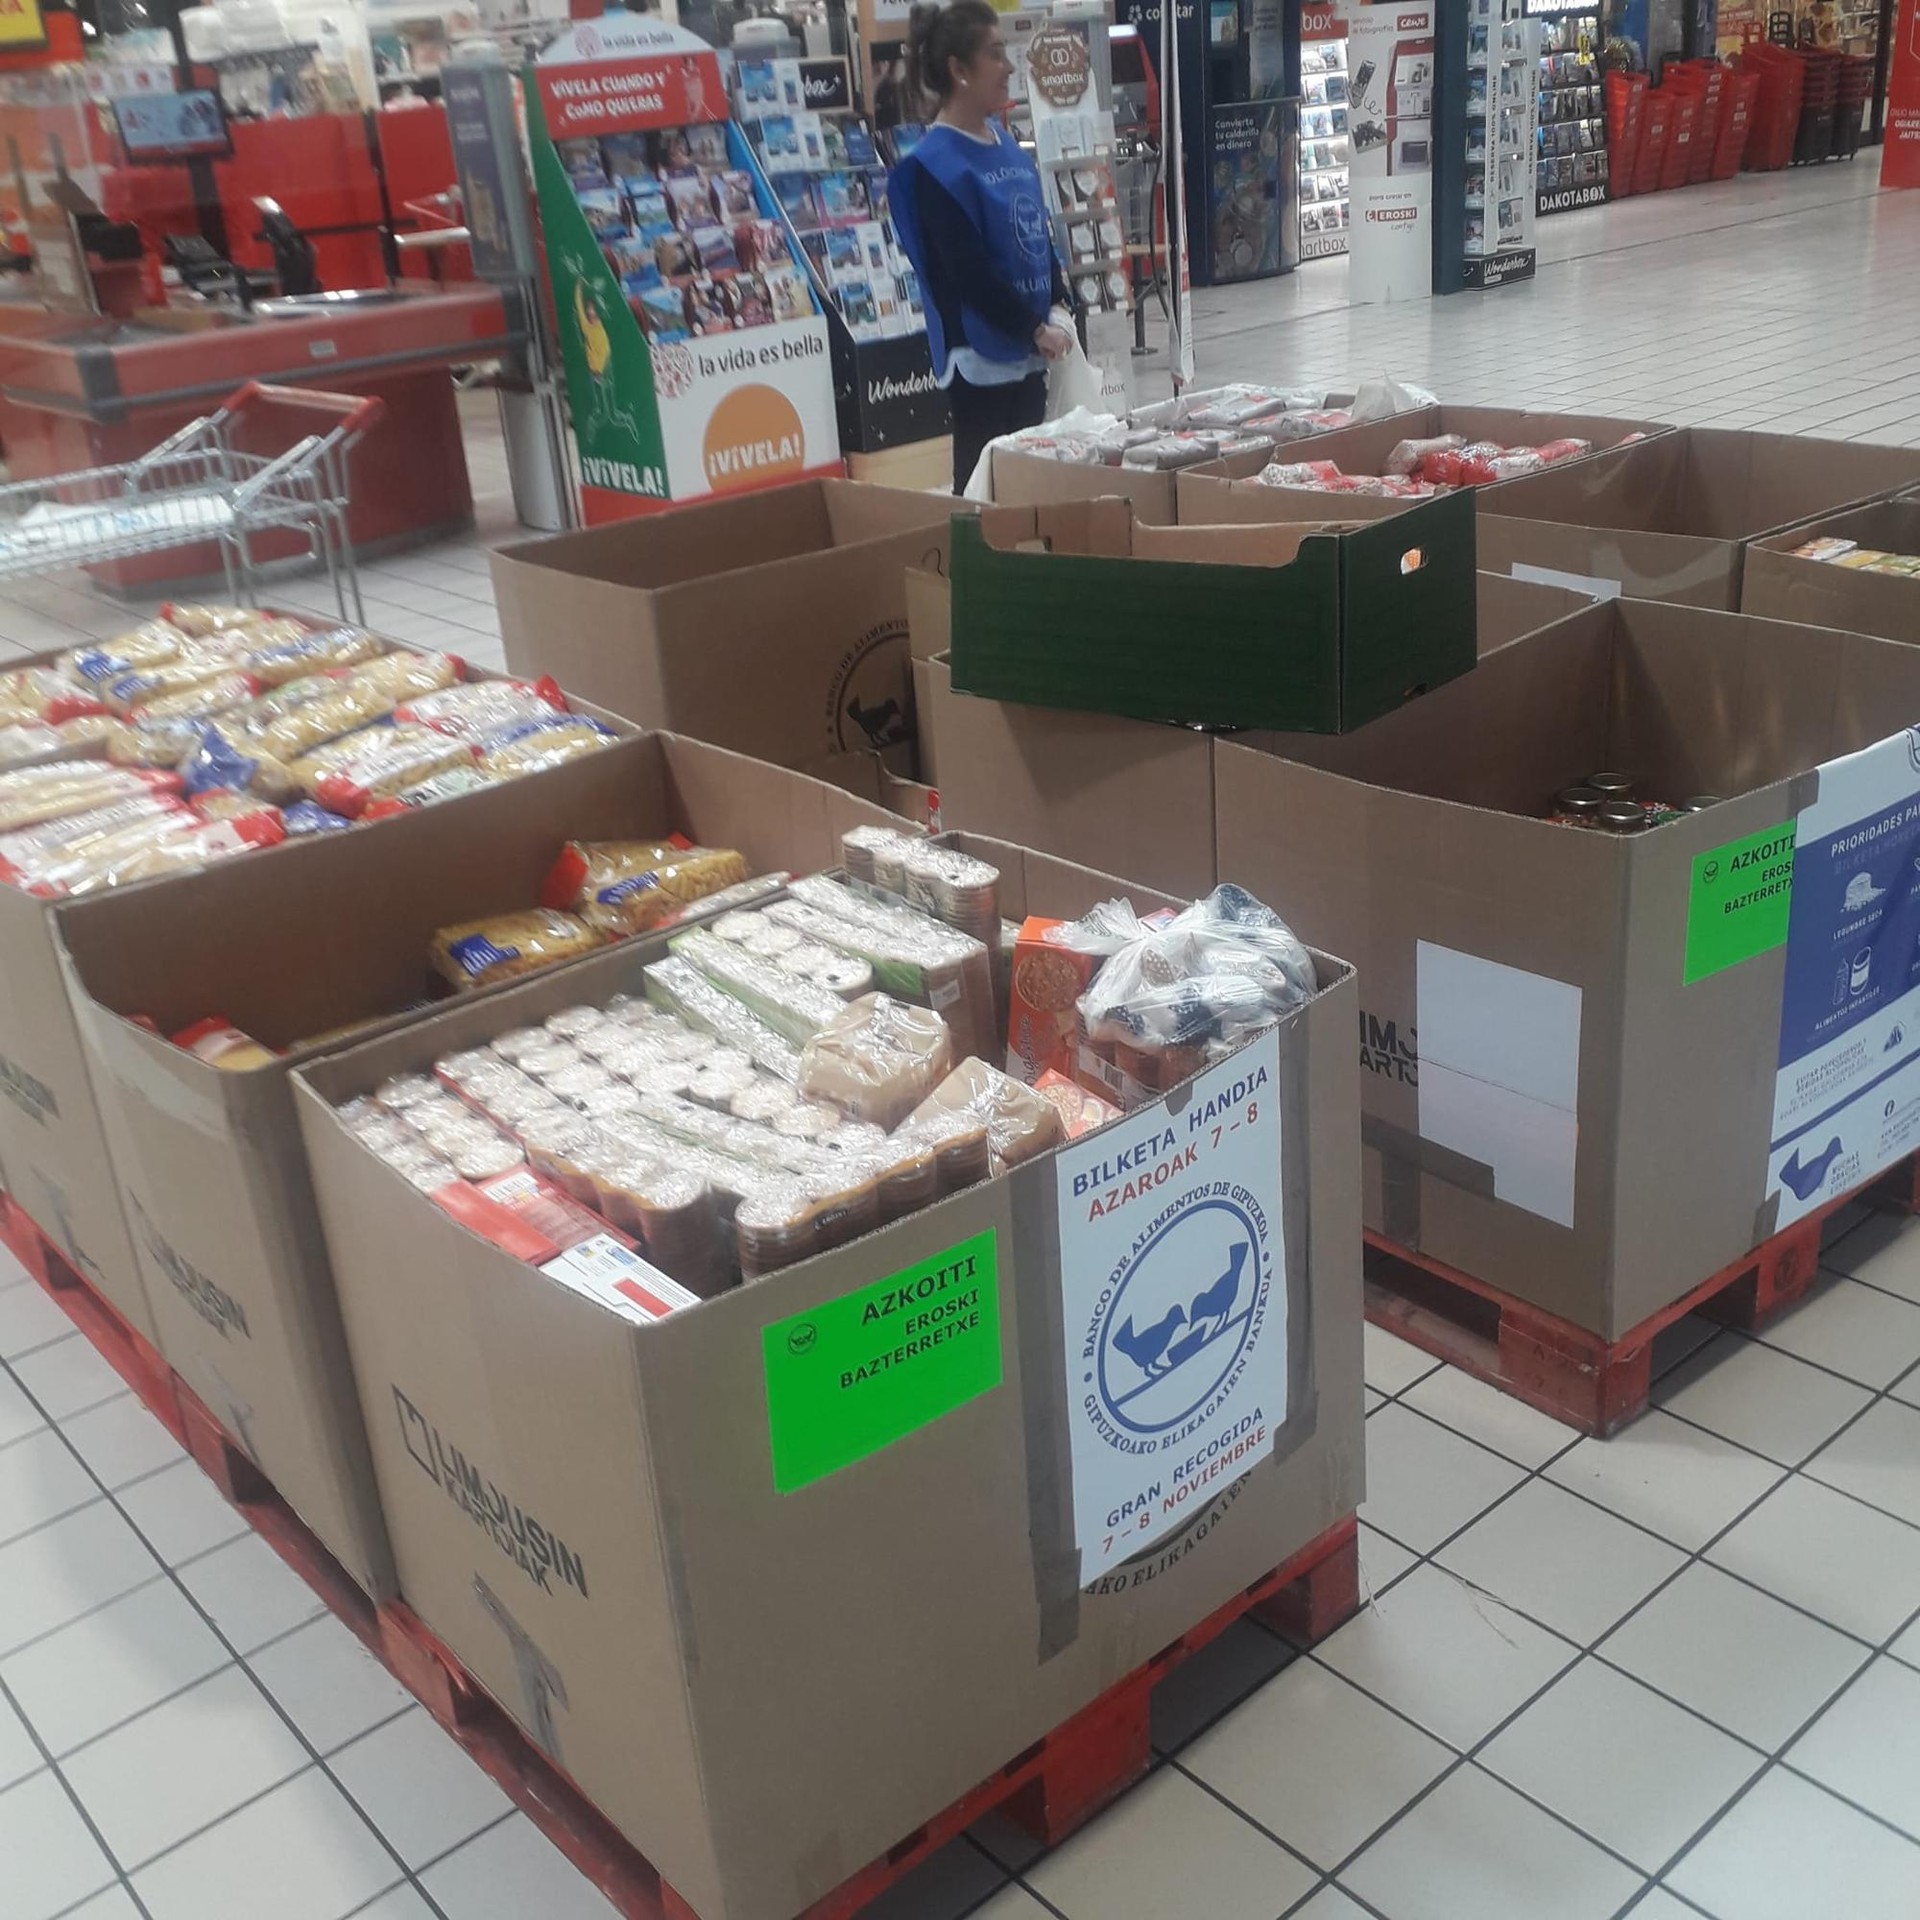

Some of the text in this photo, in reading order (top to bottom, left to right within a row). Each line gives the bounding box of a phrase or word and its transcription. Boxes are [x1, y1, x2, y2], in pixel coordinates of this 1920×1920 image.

[1379, 208, 1416, 220] EROSKI
[1540, 186, 1606, 211] DAKOTABOX
[700, 334, 823, 378] la vida es bella
[1831, 811, 1902, 858] PRIORIDADES
[1073, 1066, 1268, 1197] BILKETA HANDIA
[1088, 1141, 1198, 1222] AZAROAK
[861, 1255, 977, 1327] AZKOITI
[1083, 1181, 1269, 1359] BANCO DE ALIMENTOS DE GIPUZKOA
[840, 1311, 980, 1389] BAZTERRETXE
[905, 1288, 979, 1335] EROSKI
[1083, 1394, 1157, 1455] GIPUZKOAKO
[1246, 1267, 1273, 1353] BANKUA
[1106, 1406, 1264, 1529] GRAN RECOGIDA
[1163, 1425, 1266, 1514] NOVIEMBRE
